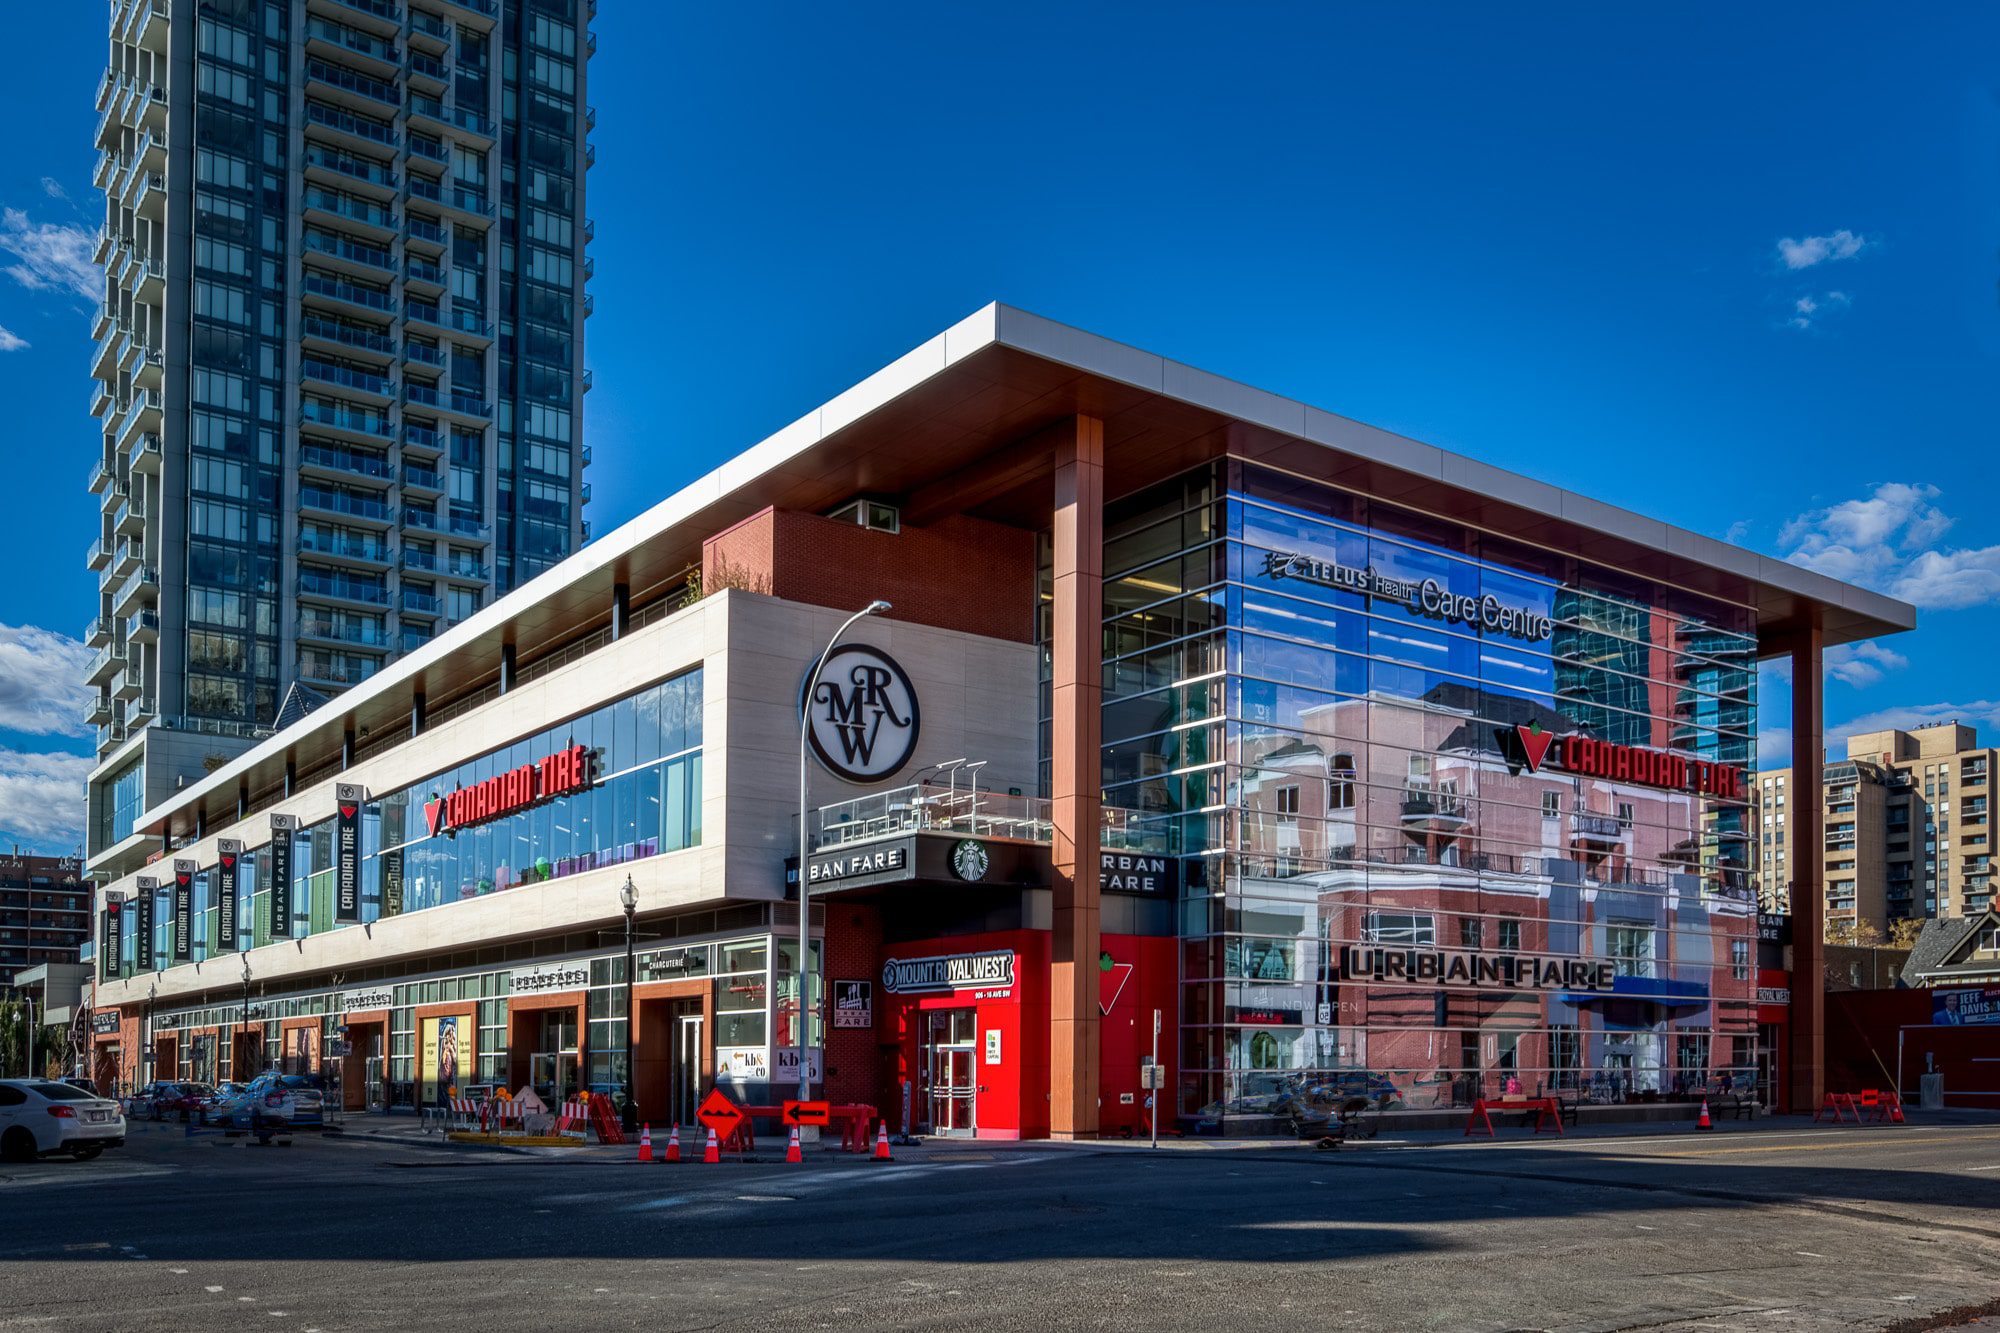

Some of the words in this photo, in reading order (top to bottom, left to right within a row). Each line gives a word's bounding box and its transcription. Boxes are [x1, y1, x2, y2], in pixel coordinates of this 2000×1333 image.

[1309, 560, 1368, 588] TELUS
[1375, 576, 1413, 600] Health
[1421, 578, 1476, 621] Care
[1482, 594, 1551, 640] Centre
[1566, 736, 1686, 788] CANADIAN
[1695, 760, 1742, 798] TIRE
[446, 764, 533, 827] CANADIAN
[539, 745, 582, 796] TIRE
[342, 827, 354, 851] TIRE
[277, 850, 285, 882] FARE
[851, 850, 897, 873] FARE
[1101, 854, 1165, 873] RBAN
[222, 873, 233, 893] TIRE
[342, 854, 354, 910] CANADIAN
[178, 890, 189, 909] TIRE
[109, 918, 118, 933] TIRE
[222, 896, 233, 941] CANADIAN
[1759, 915, 1784, 926] BAN
[178, 911, 188, 953] CANADIAN
[1758, 929, 1778, 940] RE
[108, 935, 118, 971] CANADIAN
[896, 962, 935, 985] MOUNT
[936, 959, 971, 981] ROYAL
[973, 956, 1008, 979] WEST
[1351, 946, 1500, 982] URBAN
[1514, 955, 1614, 989] FARE
[1775, 990, 1790, 1001] WEST
[1960, 992, 1980, 1004] JEFF
[1332, 1002, 1358, 1012] PEN
[1960, 1001, 1990, 1015] DAVIS
[836, 1018, 871, 1026] FARE
[745, 1053, 764, 1067] kb&
[755, 1067, 766, 1077] co
